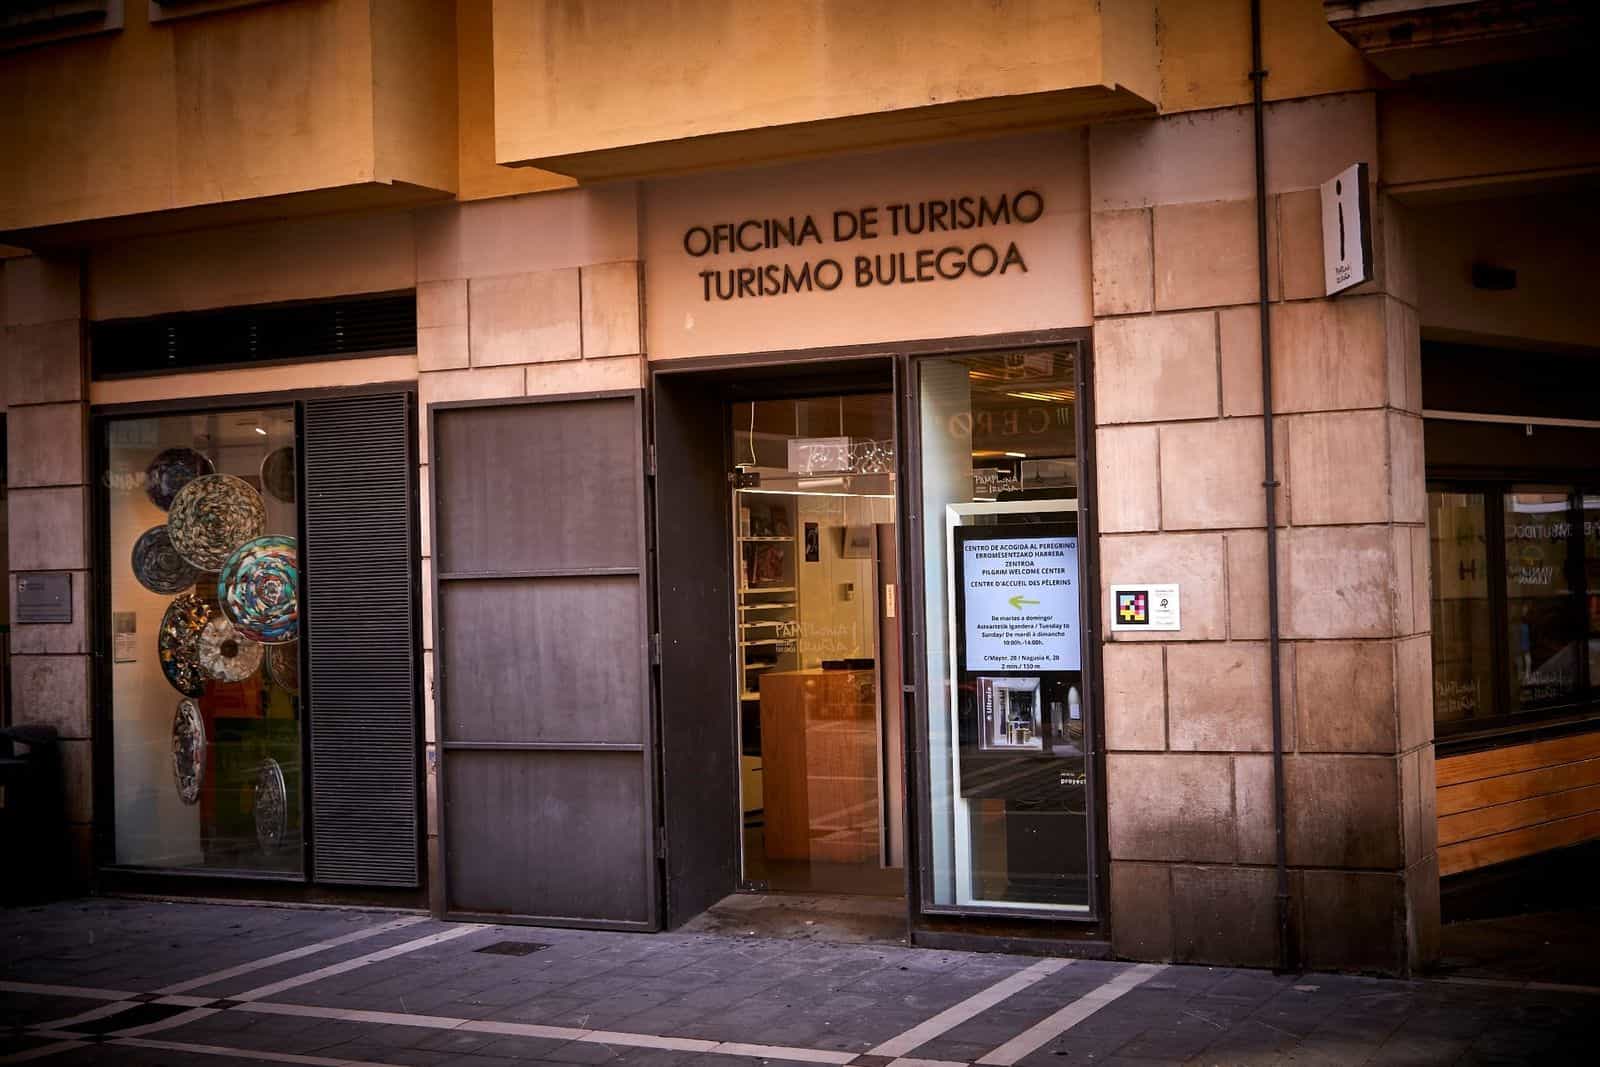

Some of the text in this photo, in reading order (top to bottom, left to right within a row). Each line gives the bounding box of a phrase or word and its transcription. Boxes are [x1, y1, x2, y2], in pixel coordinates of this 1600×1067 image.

[683, 190, 1045, 257] OFICINA DE TURISMO
[698, 241, 1028, 302] TURISMO BULEGOA
[1000, 543, 1029, 551] ACOGIDA
[1039, 542, 1076, 550] PEREGRINO
[1034, 550, 1065, 558] HARRERA
[981, 568, 1008, 576] PILGRIM
[1008, 567, 1040, 575] WELCOME
[970, 580, 994, 588] CENTRE
